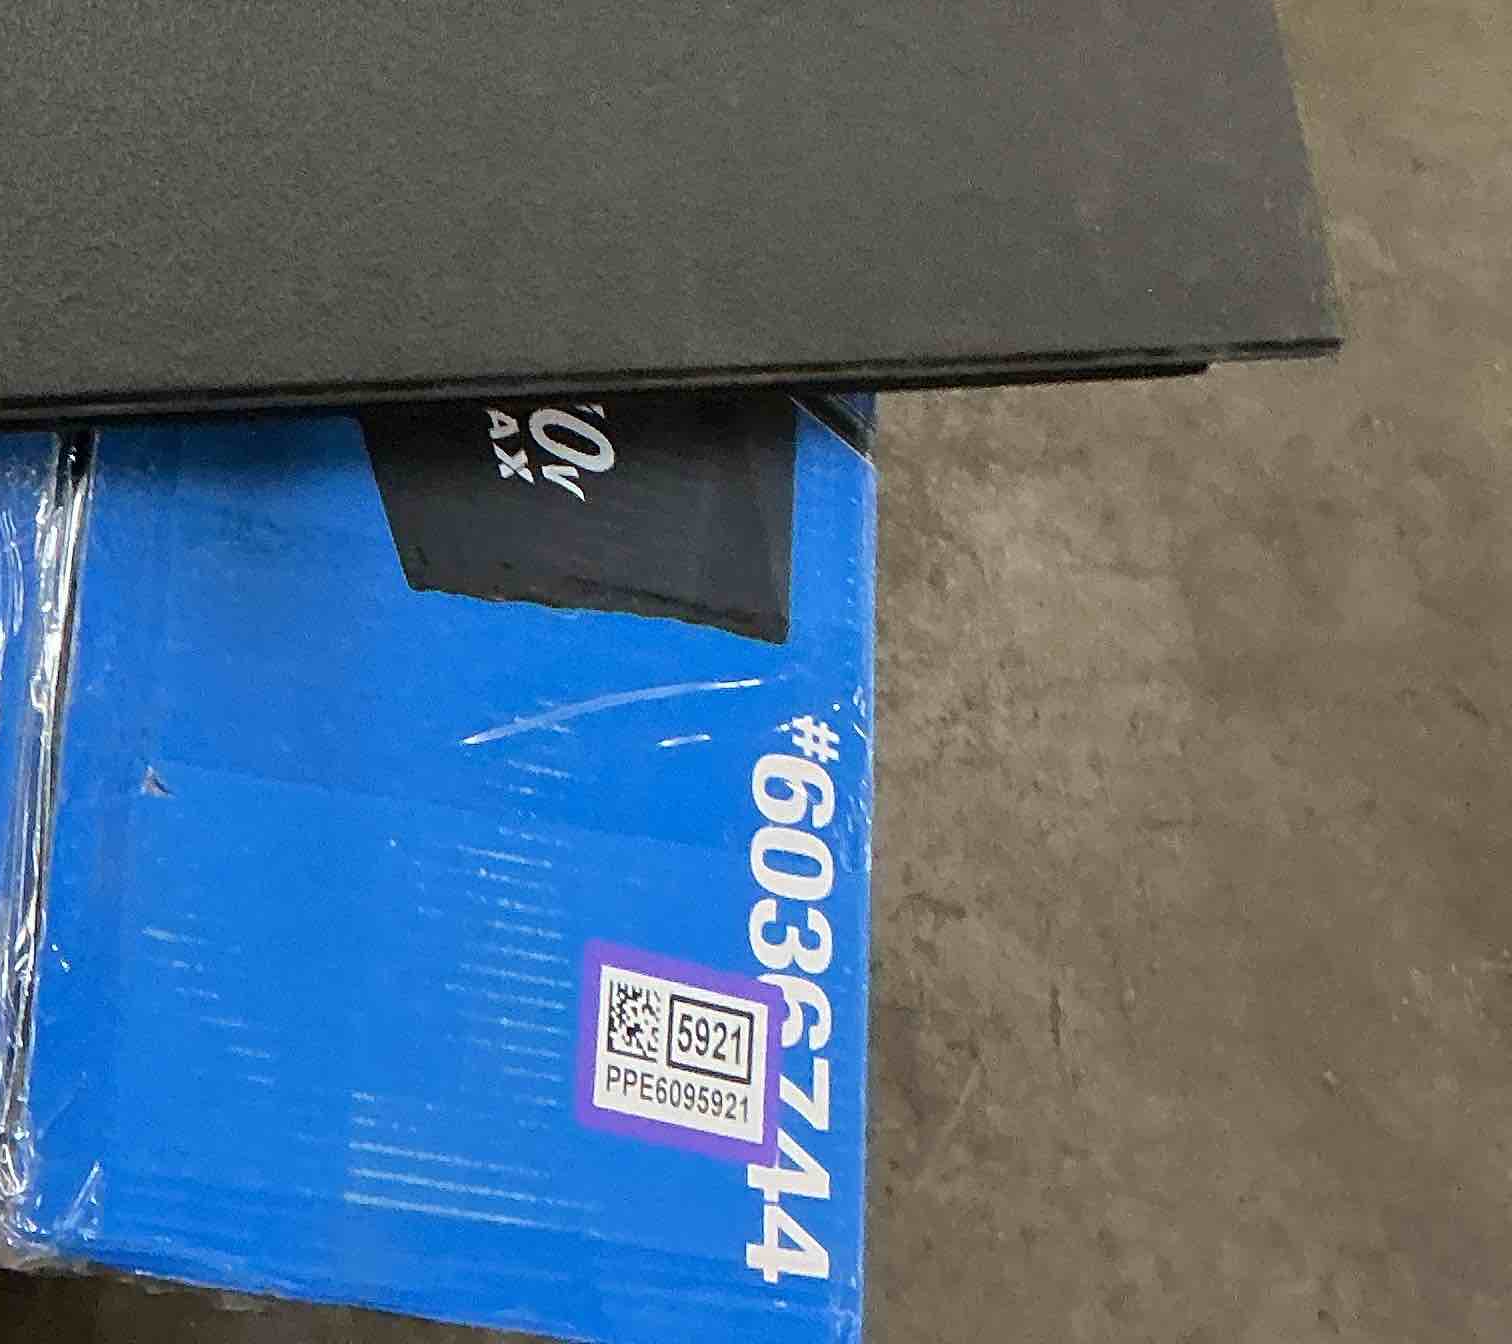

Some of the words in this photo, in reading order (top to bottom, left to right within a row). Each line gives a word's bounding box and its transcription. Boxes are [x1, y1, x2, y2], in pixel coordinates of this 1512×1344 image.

[745, 713, 840, 1285] #6036744
[675, 1014, 745, 1066] 5921
[604, 1064, 750, 1124] PPE6095921
